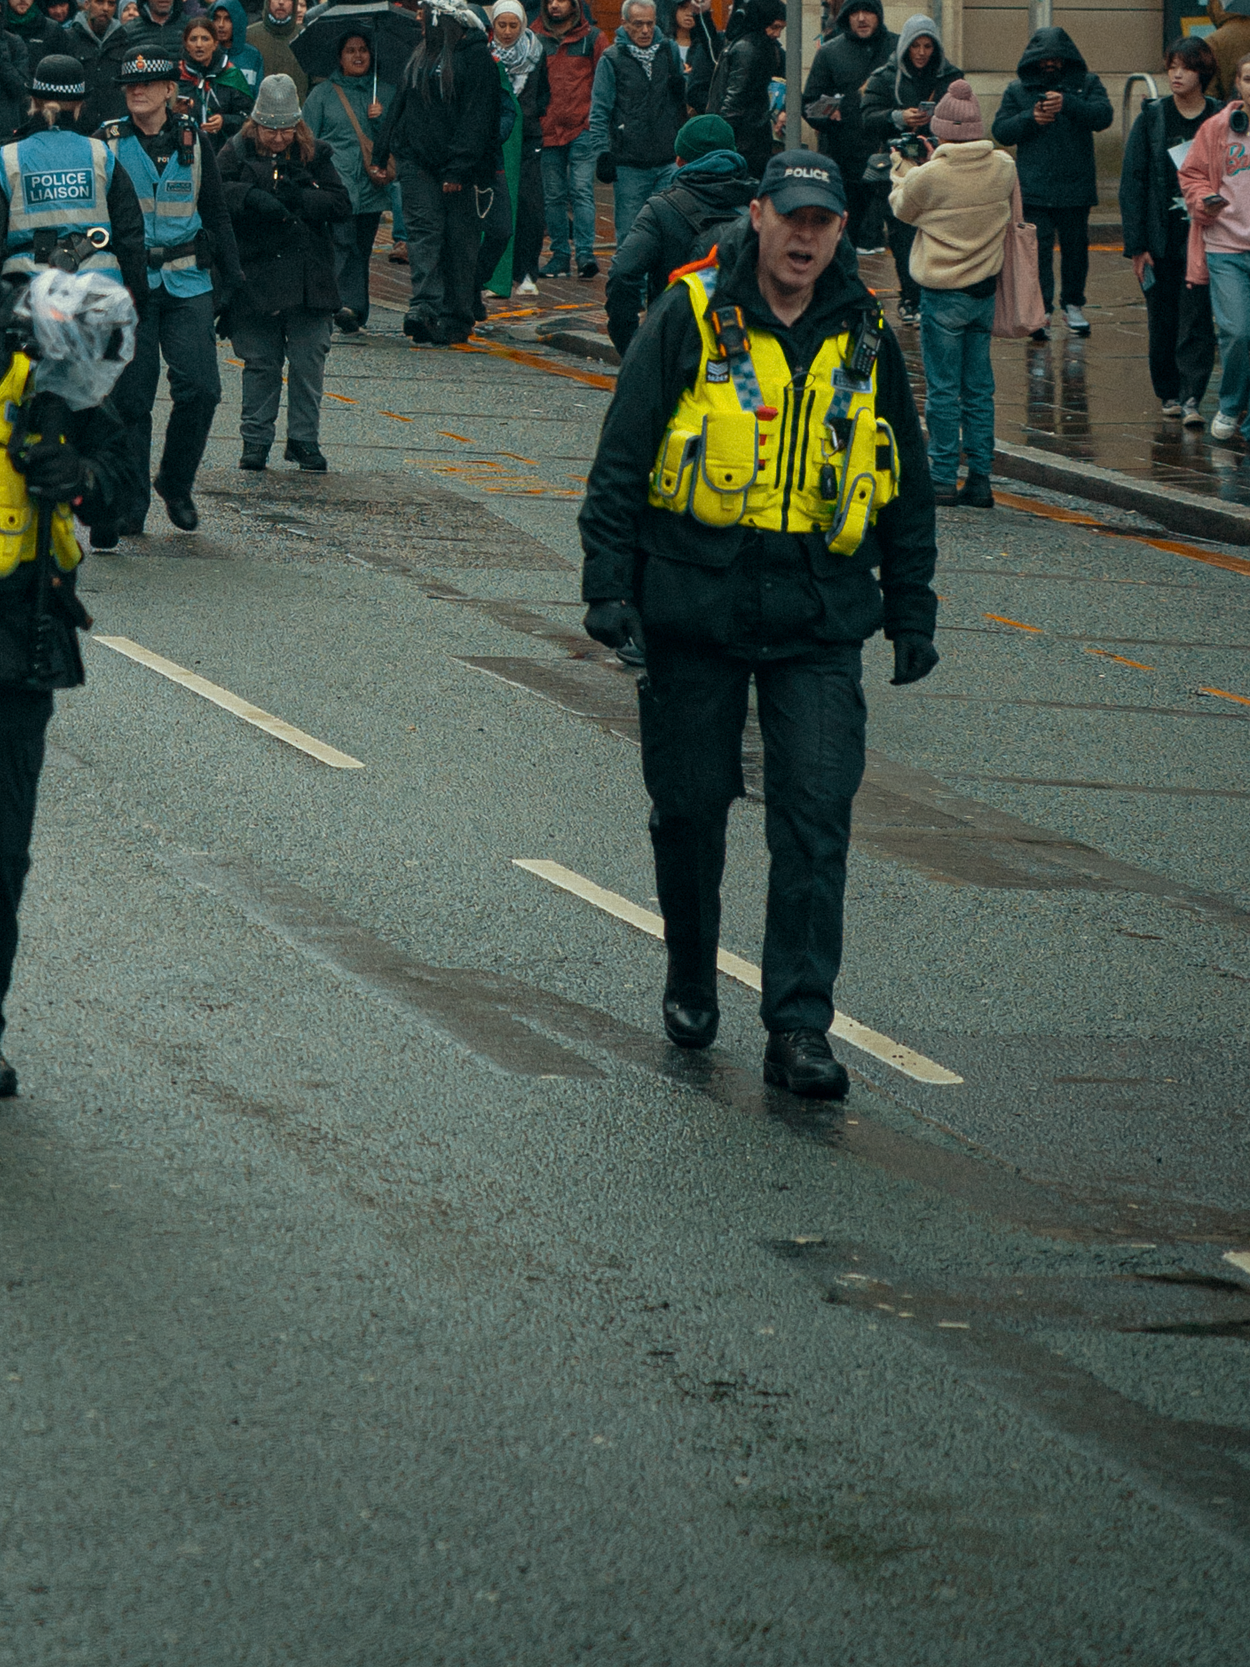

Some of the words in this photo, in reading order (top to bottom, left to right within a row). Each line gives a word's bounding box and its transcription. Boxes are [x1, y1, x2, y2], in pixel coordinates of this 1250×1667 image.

[31, 172, 87, 188] POLICE
[783, 167, 830, 184] POLICE
[30, 185, 90, 202] LIAISON
